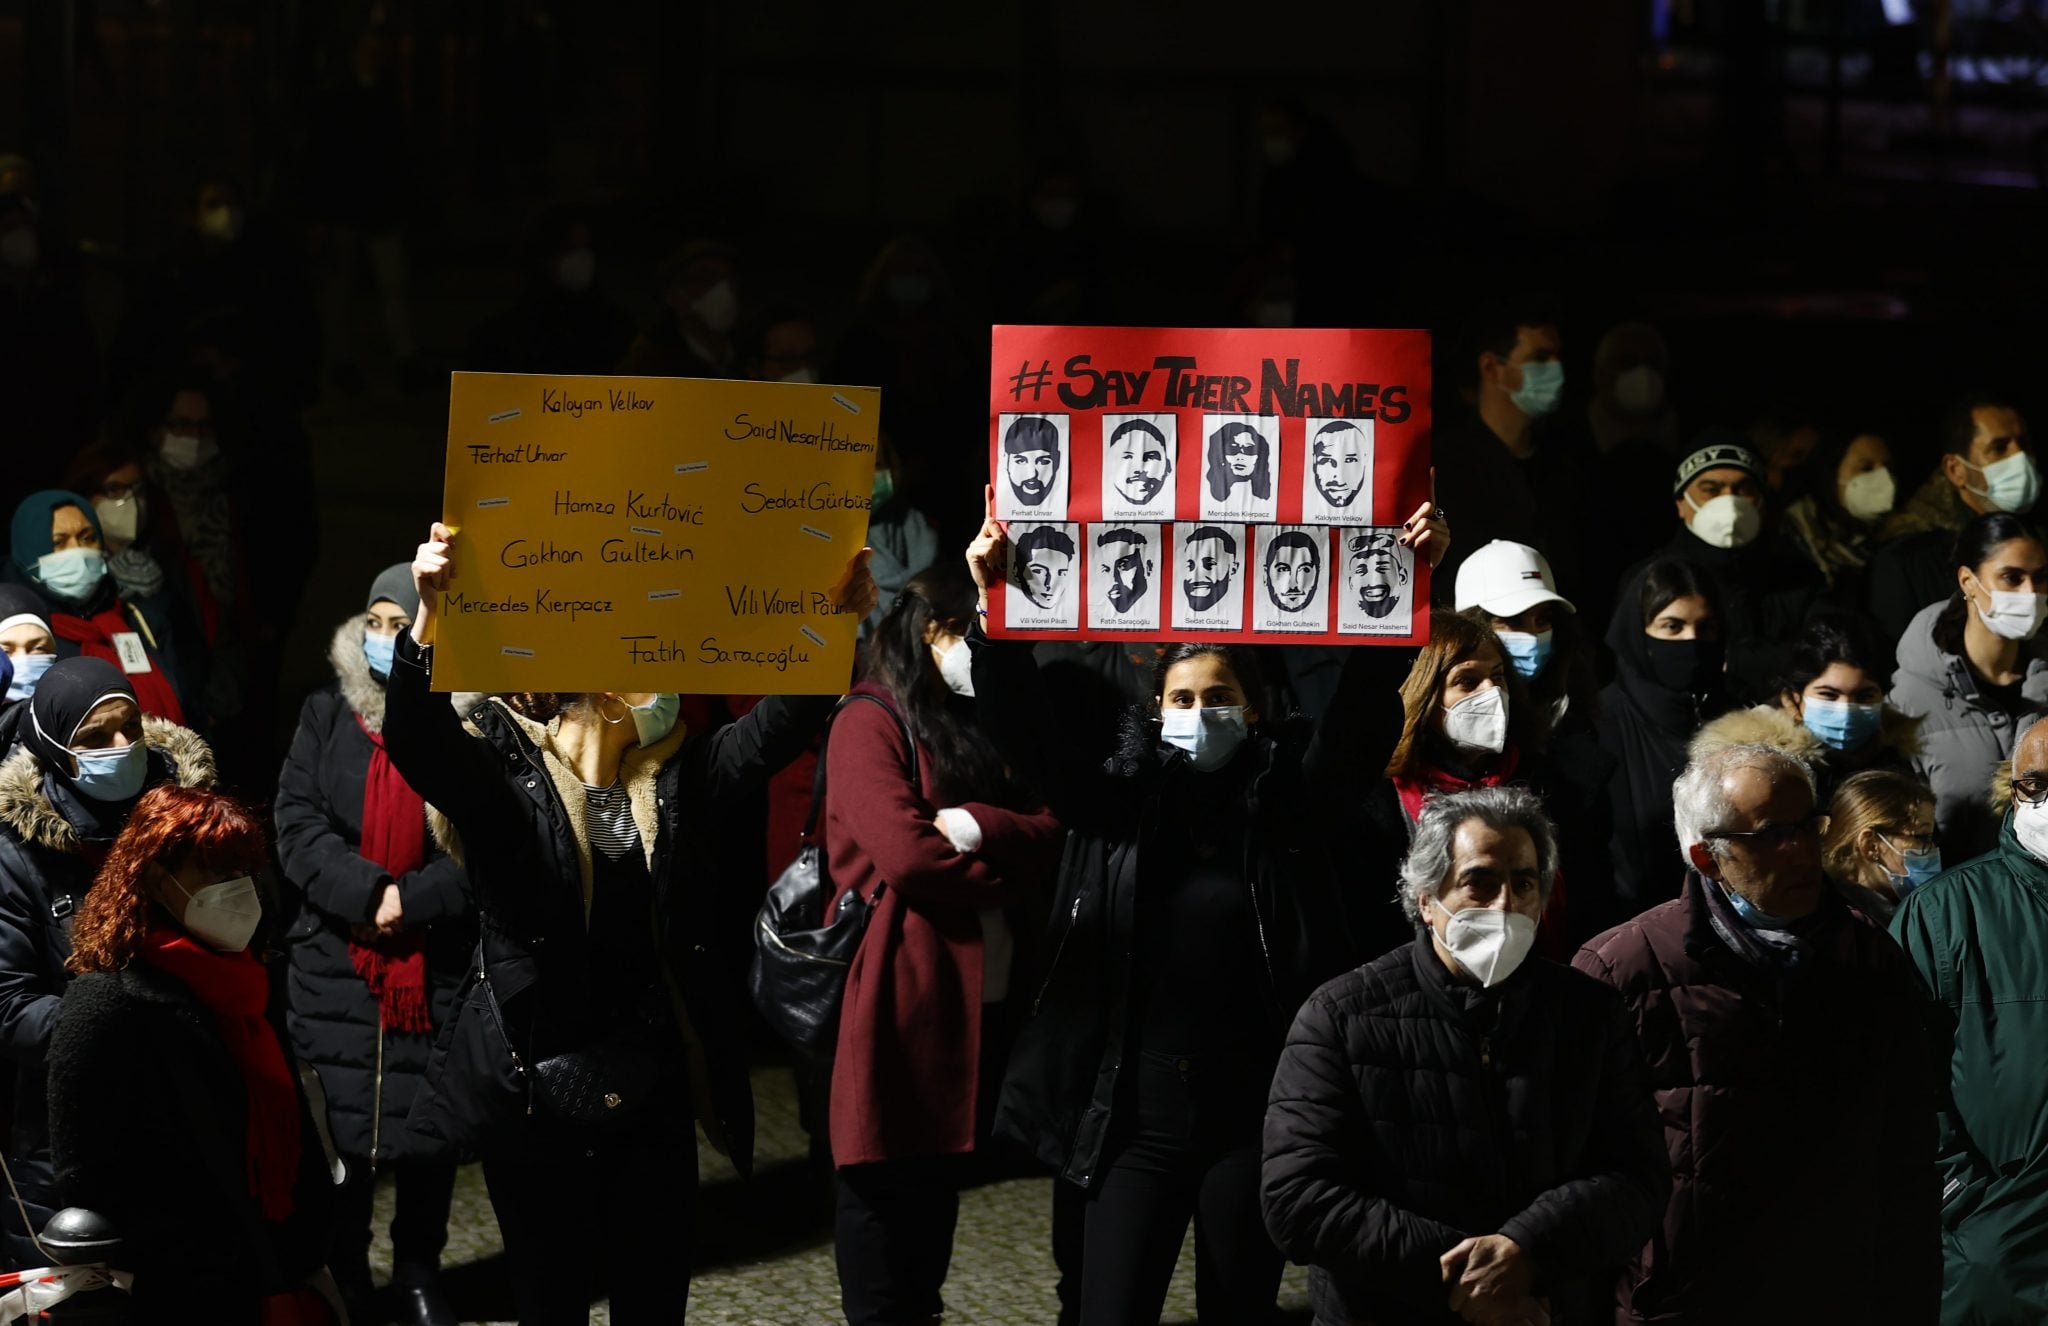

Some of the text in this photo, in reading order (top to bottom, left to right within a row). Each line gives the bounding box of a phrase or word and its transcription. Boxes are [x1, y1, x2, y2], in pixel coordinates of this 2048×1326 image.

[542, 388, 602, 418] Kaloyan
[608, 389, 655, 412] Velkov
[1009, 354, 1411, 424] #SAY THEIR NAMES
[724, 413, 875, 453] Said Nesar Hashemi
[467, 443, 568, 464] Ferhat Unvar
[555, 489, 704, 526] Hamza Kurtović
[741, 481, 872, 513] Sedat Gürbüz
[1011, 509, 1033, 517] Ferhat
[1207, 510, 1240, 518] Mercedes
[444, 589, 614, 622] Mercedes Kierpacz
[763, 588, 805, 616] Viorel
[620, 635, 809, 672] Fatih Saraçoğlu
